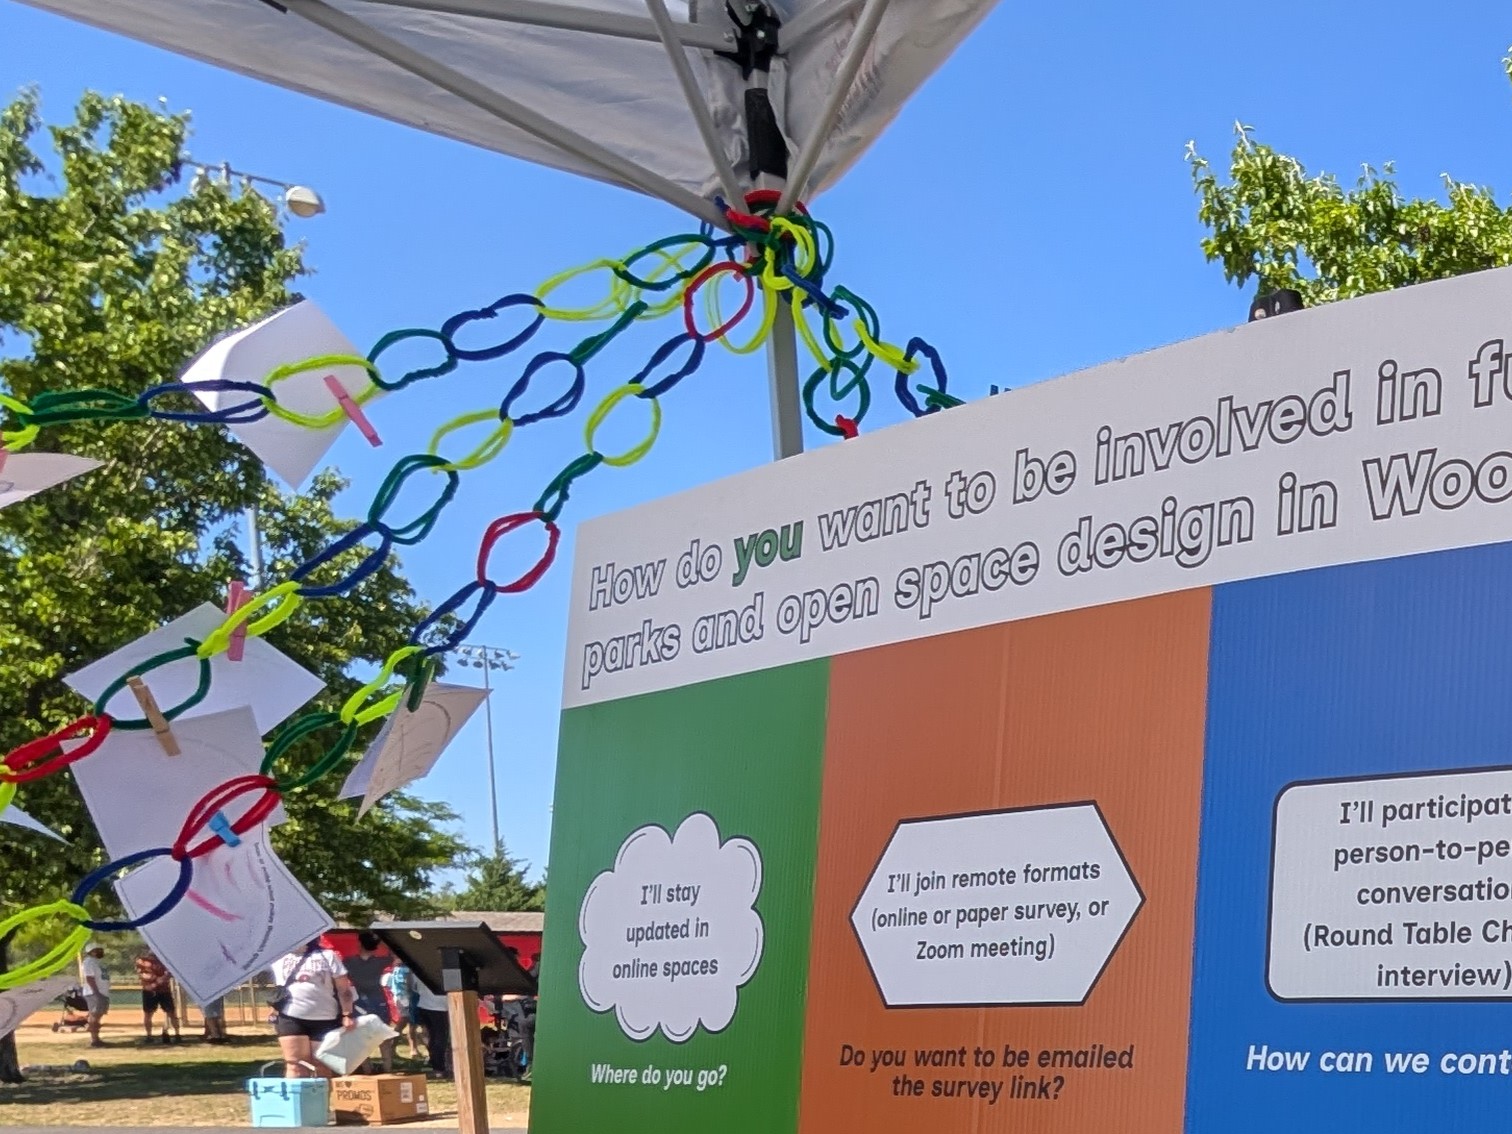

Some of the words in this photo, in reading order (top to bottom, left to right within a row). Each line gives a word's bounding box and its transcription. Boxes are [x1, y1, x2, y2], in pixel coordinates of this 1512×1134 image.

[588, 559, 667, 611] How
[676, 539, 722, 588] do
[732, 520, 804, 586] you
[818, 480, 931, 551] want
[944, 470, 996, 519] to
[1013, 448, 1076, 504] be
[1094, 369, 1353, 485] involved
[1377, 359, 1443, 425] in
[581, 619, 681, 690] parks
[692, 592, 764, 654] and
[776, 576, 880, 644] open
[894, 541, 1040, 620] space
[1057, 496, 1255, 577] design
[1277, 471, 1338, 536] in
[1340, 799, 1375, 824] I'll
[887, 873, 911, 893] I'll
[913, 870, 946, 897] join
[951, 866, 1017, 889] remote
[1023, 861, 1101, 884] formats
[640, 883, 662, 905] I'll
[666, 883, 701, 907] stay
[871, 906, 928, 931] (online
[933, 909, 951, 924] or
[955, 905, 1009, 929] paper
[1014, 899, 1082, 923] survey,
[1088, 899, 1110, 916] or
[626, 918, 690, 948] updated
[695, 917, 709, 938] in
[916, 940, 964, 960] Zoom
[970, 933, 1055, 961] meeting)
[1303, 922, 1394, 952] (Round
[1402, 919, 1472, 946] Table
[612, 958, 658, 979] online
[663, 958, 719, 982] spaces
[839, 1044, 865, 1067] Do
[870, 1049, 906, 1072] you
[914, 1046, 966, 1067] want
[974, 1046, 995, 1067] to
[1002, 1045, 1031, 1068] be
[1038, 1044, 1135, 1069] emailed
[1245, 1044, 1311, 1072] How
[1318, 1049, 1373, 1073] can
[1384, 1051, 1430, 1073] we
[591, 1063, 638, 1084] Where
[641, 1065, 661, 1085] do
[663, 1069, 693, 1091] you
[696, 1064, 728, 1091] go?
[892, 1074, 925, 1096] the
[931, 1080, 1003, 1105] survey
[1010, 1075, 1065, 1100] link?
[336, 1090, 372, 1101] PROMOS
